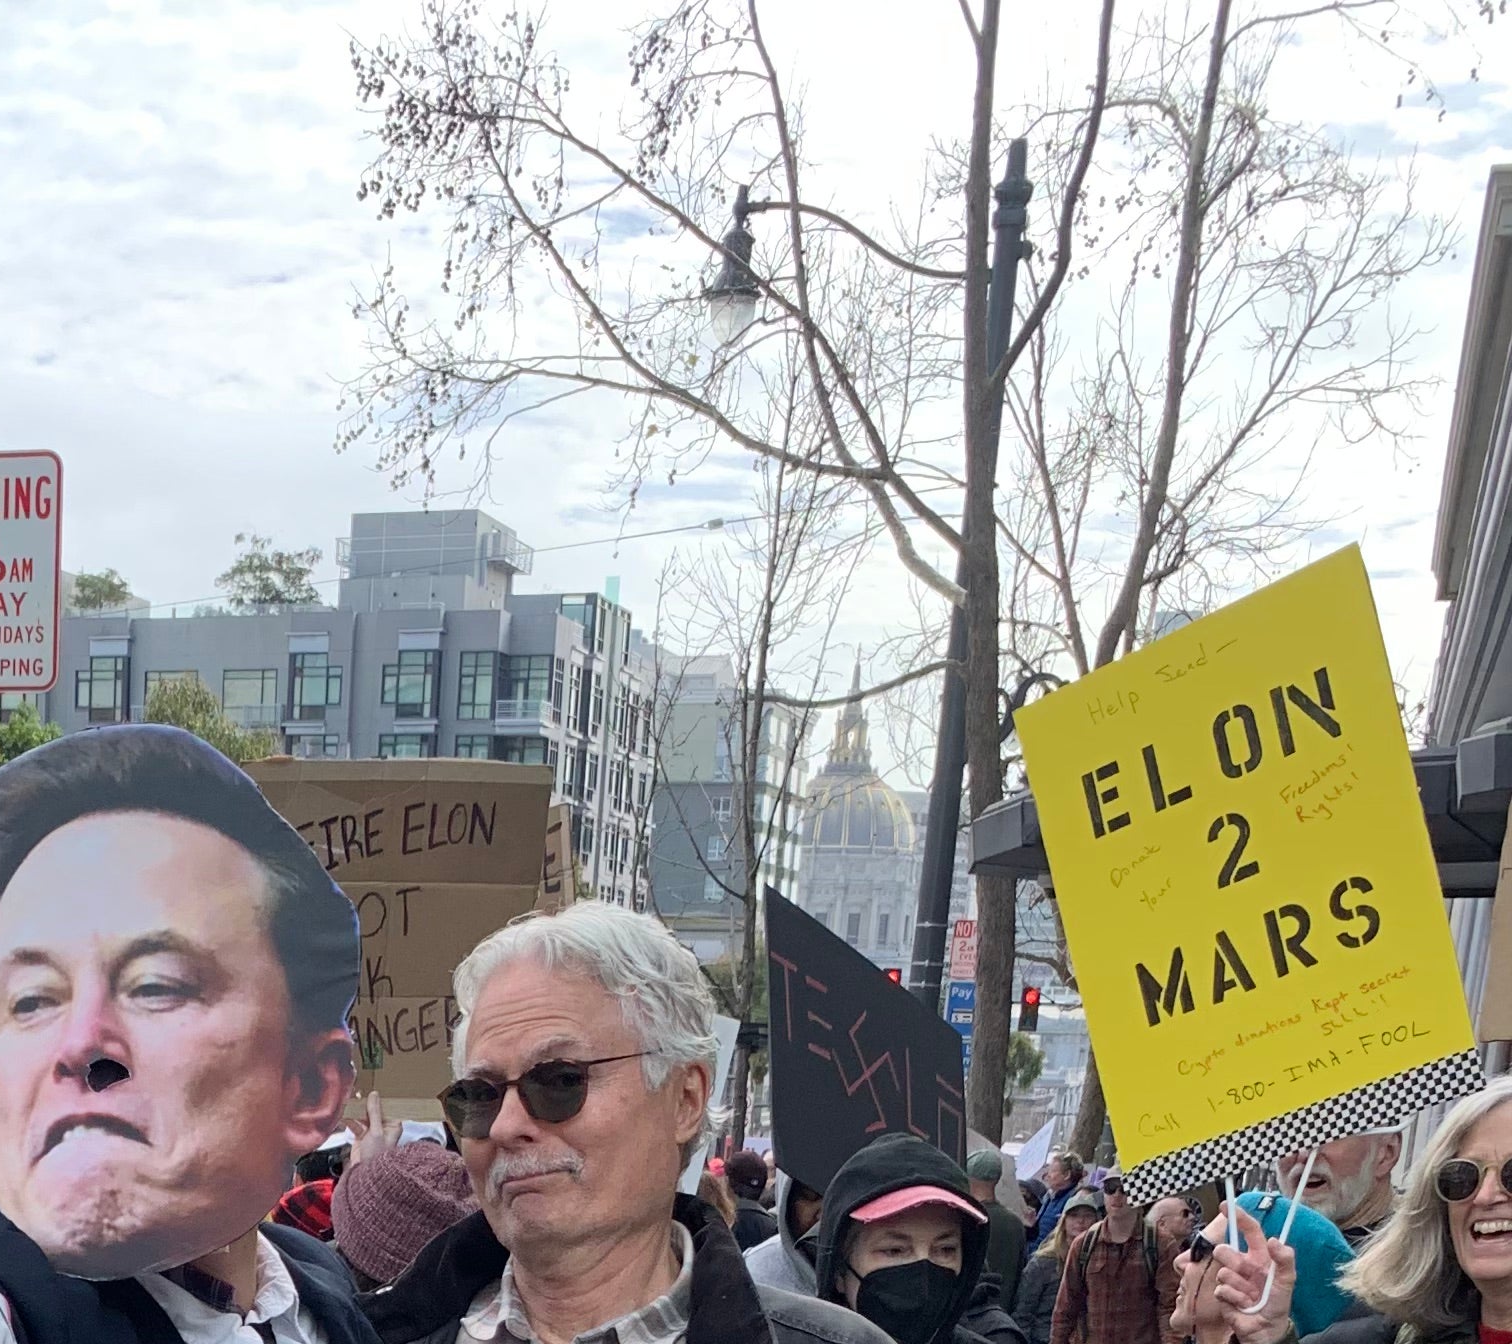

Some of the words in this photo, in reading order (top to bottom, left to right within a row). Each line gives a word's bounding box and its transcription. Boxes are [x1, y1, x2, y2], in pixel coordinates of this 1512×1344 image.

[1088, 688, 1140, 726] Help
[1081, 666, 1343, 840] ELON
[400, 800, 497, 856] ELON
[1207, 812, 1260, 889] 2
[956, 921, 971, 937] NO
[1135, 876, 1381, 1028] MARS
[951, 986, 973, 1000] Pay
[1138, 1112, 1181, 1138] Call
